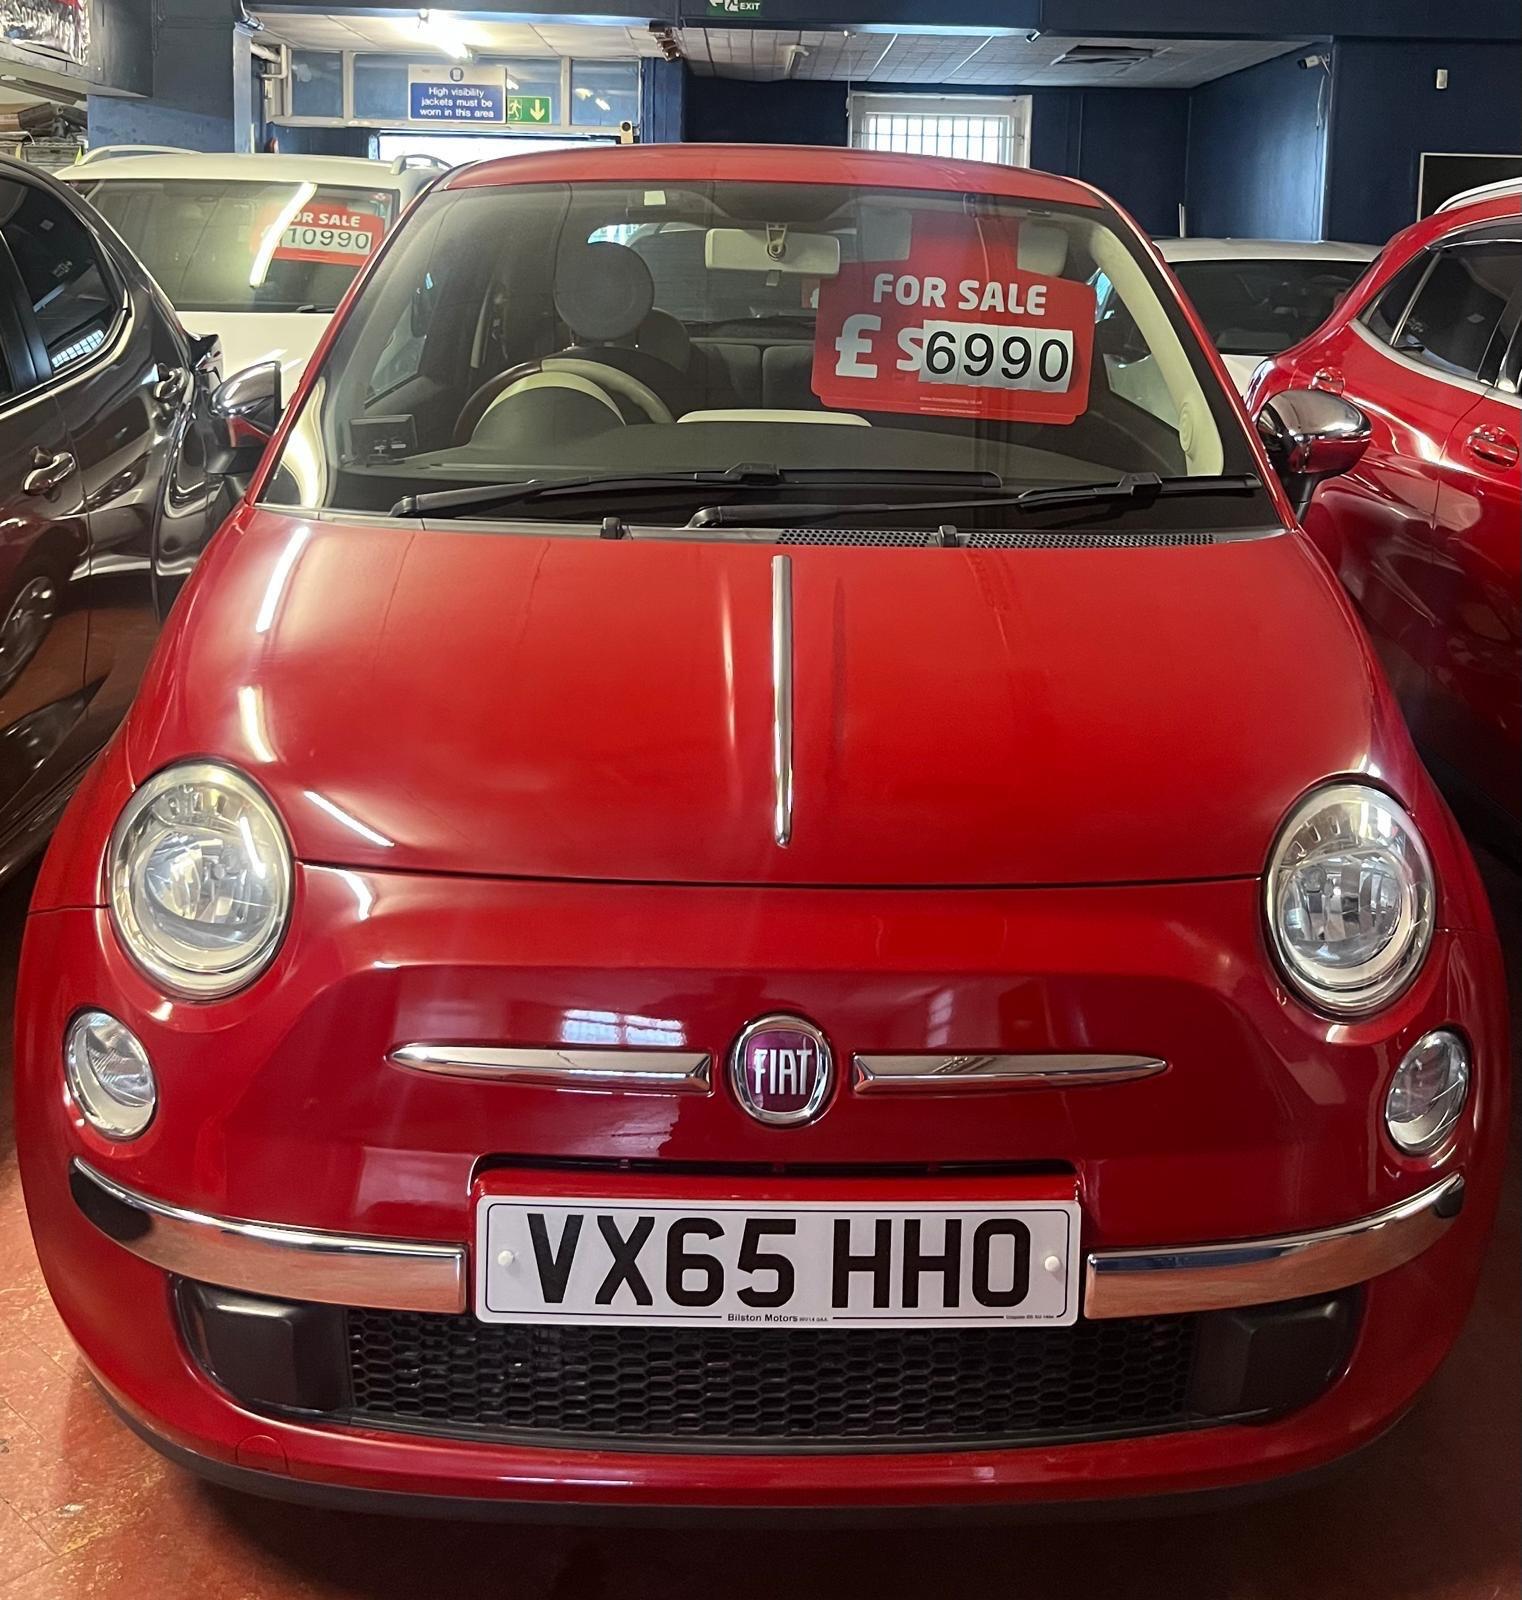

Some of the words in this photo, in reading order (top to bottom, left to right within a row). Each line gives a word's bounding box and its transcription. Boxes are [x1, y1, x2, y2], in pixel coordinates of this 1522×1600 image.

[740, 2, 760, 10] EXIT
[428, 87, 449, 97] High
[451, 88, 485, 98] visibility
[421, 97, 453, 107] jackets
[456, 99, 478, 107] must
[481, 99, 493, 108] be
[444, 108, 452, 117] in
[455, 108, 471, 117] this
[474, 110, 494, 118] area
[318, 213, 361, 227] SALE
[287, 227, 369, 250] 10990
[872, 273, 947, 308] FOR
[958, 279, 1048, 316] SALE
[835, 313, 882, 379] £
[925, 330, 1069, 383] 6990
[753, 1048, 813, 1095] FIAT
[526, 1213, 797, 1308] VX65
[831, 1218, 1031, 1309] HHO
[727, 1313, 762, 1322] Bilston
[764, 1314, 798, 1322] Motors
